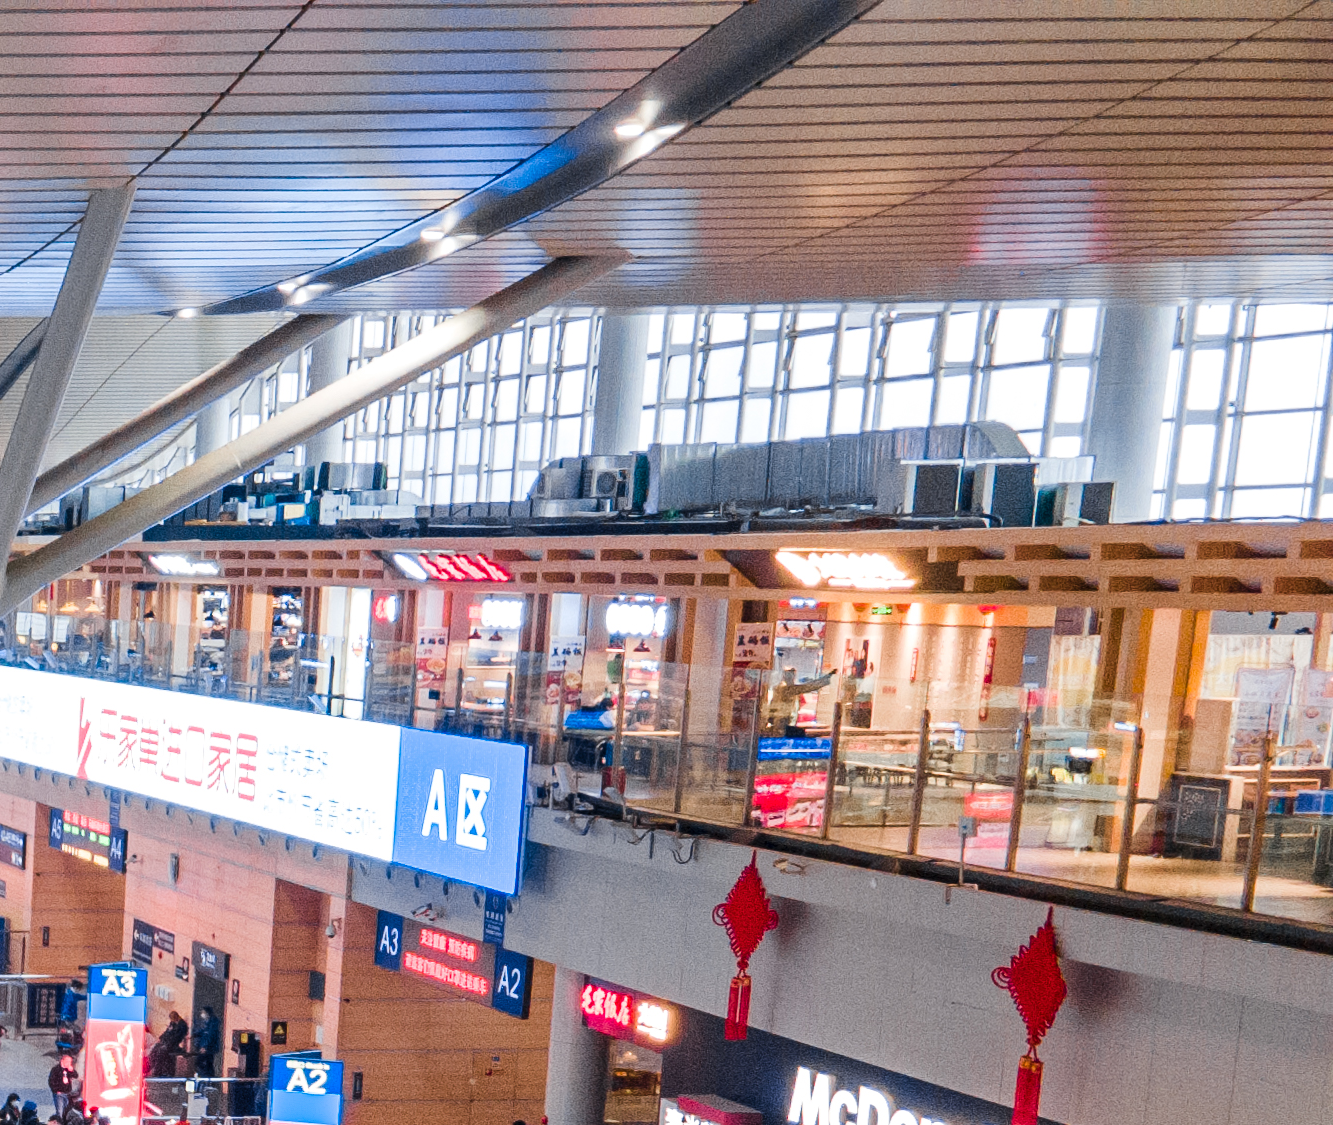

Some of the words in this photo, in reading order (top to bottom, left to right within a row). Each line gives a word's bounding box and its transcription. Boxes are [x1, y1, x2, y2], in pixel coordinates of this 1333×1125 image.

[421, 768, 490, 850] A区
[51, 817, 62, 840] A5
[110, 836, 122, 860] A4
[379, 925, 399, 956] A3
[101, 975, 136, 997] A3
[497, 965, 521, 999] A2
[286, 1068, 328, 1095] A2
